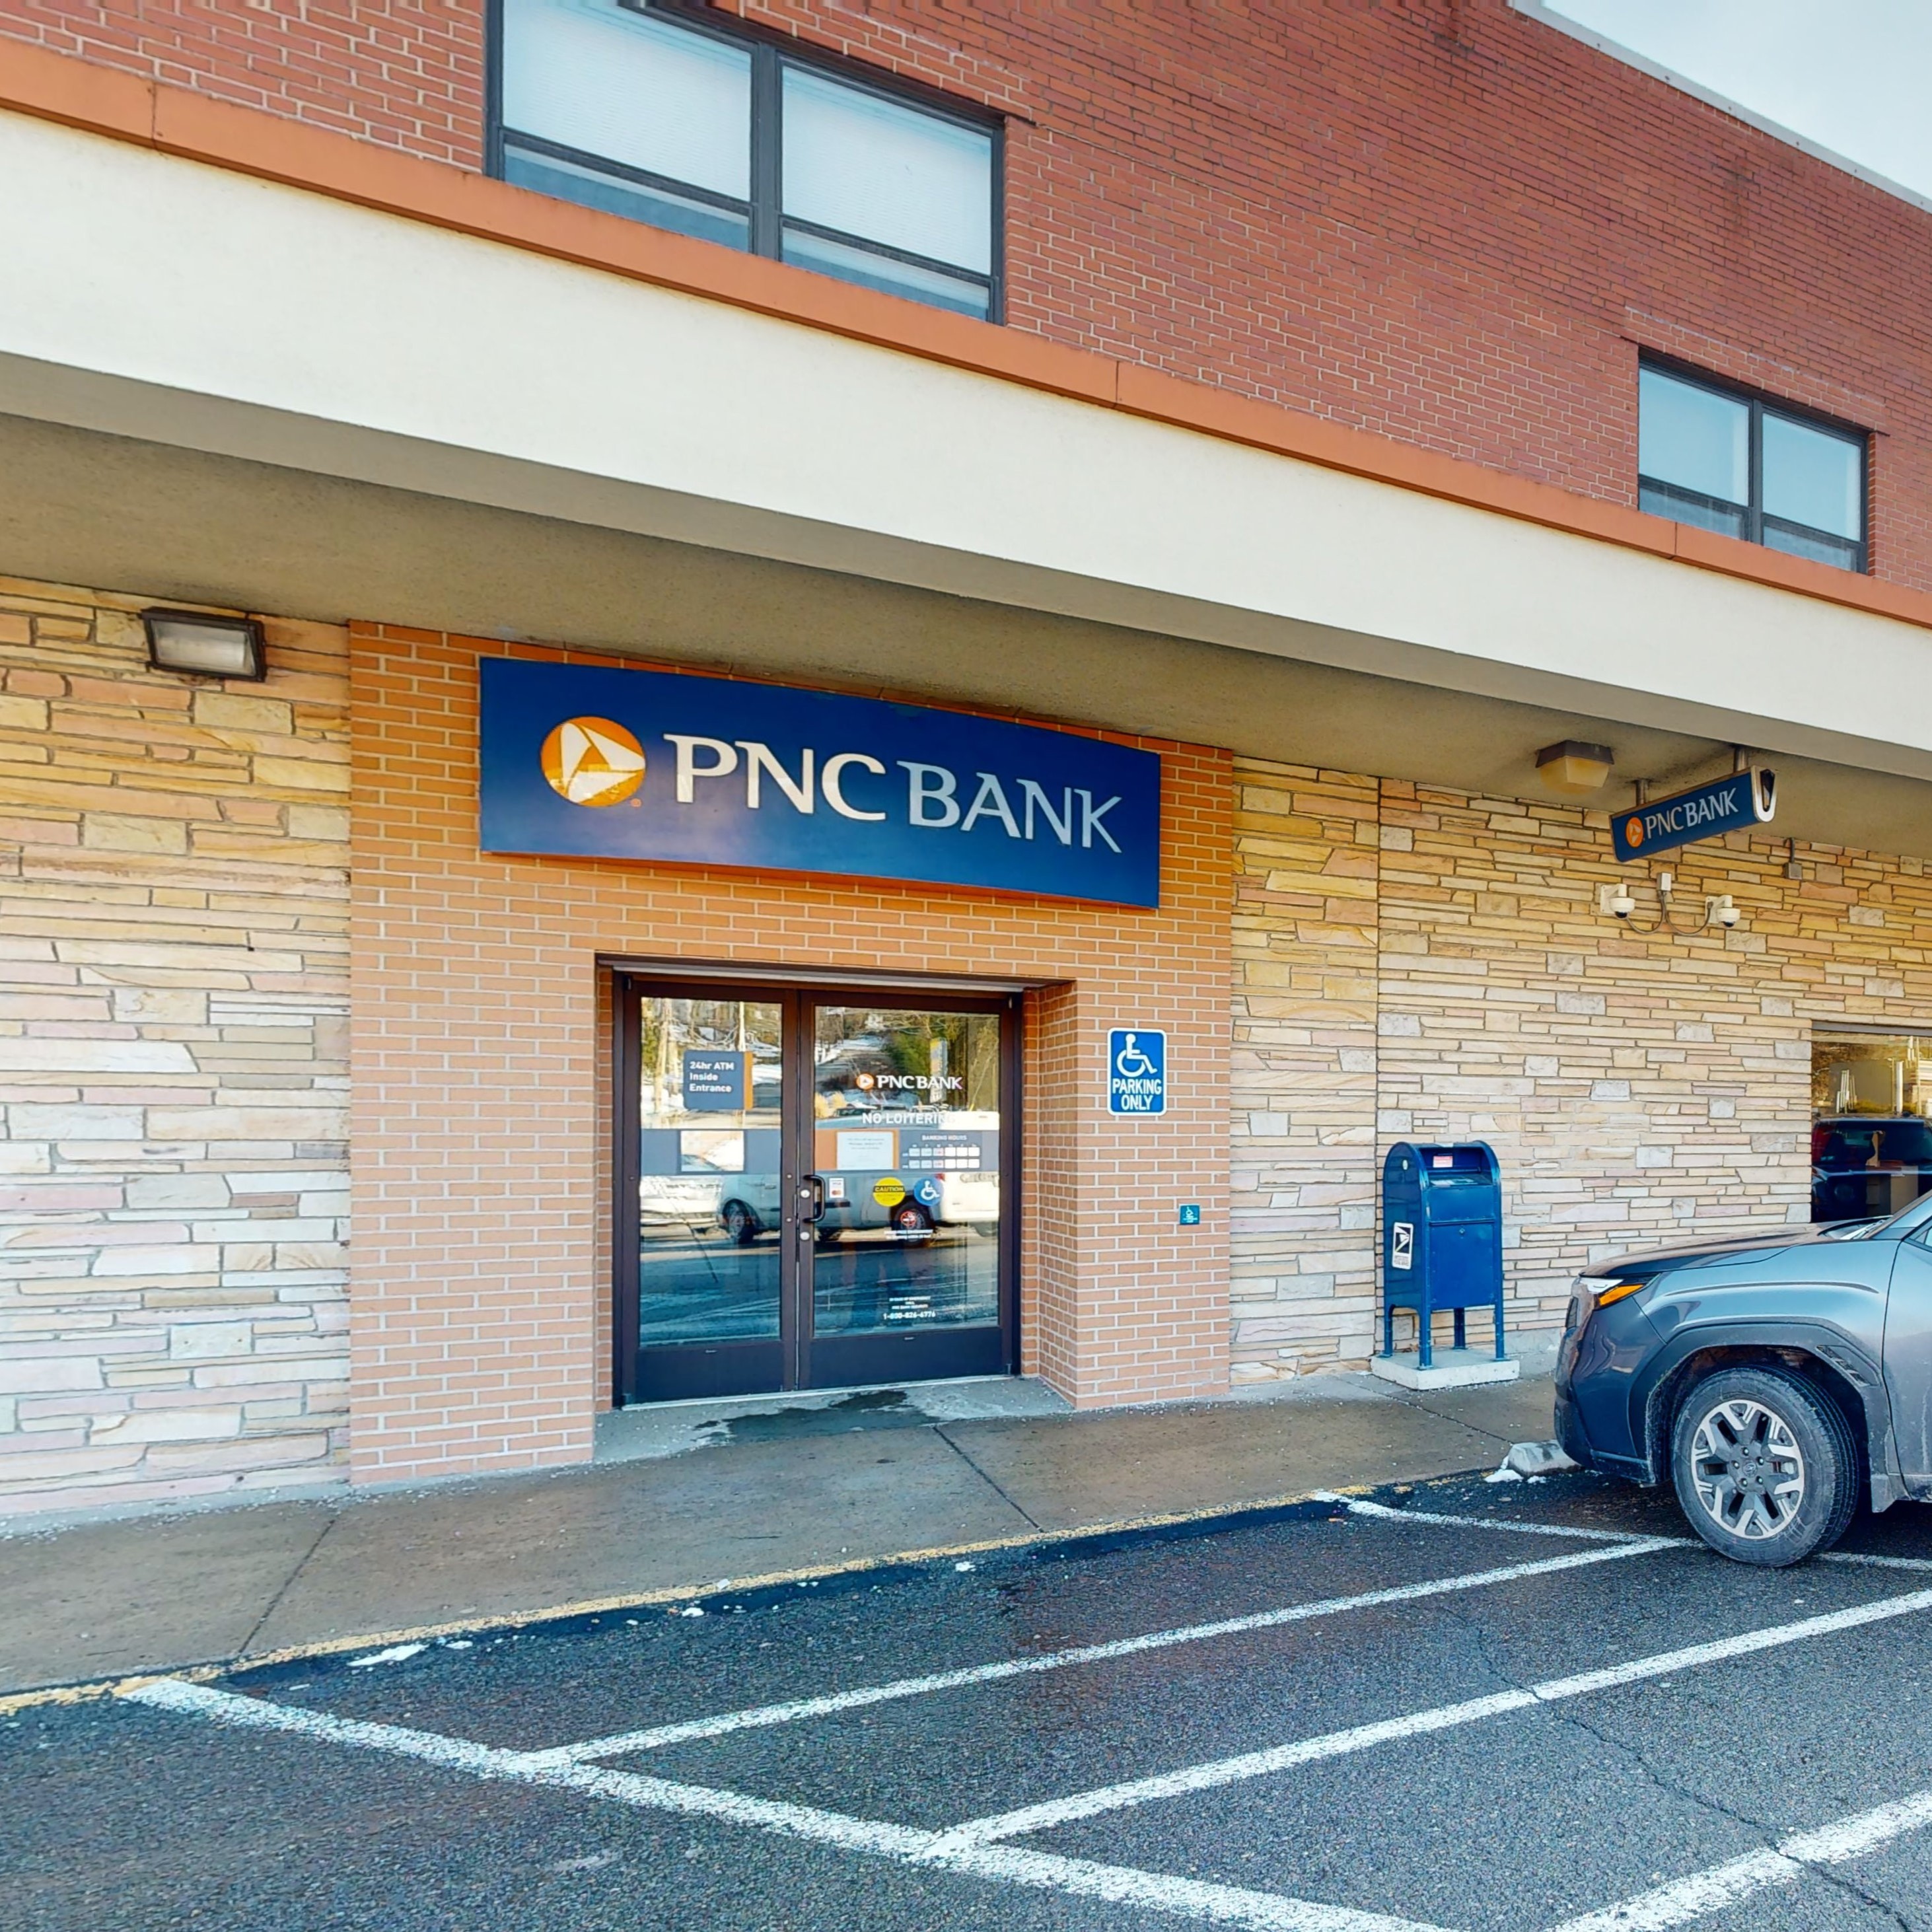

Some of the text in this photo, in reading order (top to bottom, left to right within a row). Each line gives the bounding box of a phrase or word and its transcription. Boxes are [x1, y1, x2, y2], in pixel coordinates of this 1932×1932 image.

[664, 733, 1122, 853] PNC BANK
[1644, 787, 1738, 840] PNC BANK
[689, 1061, 734, 1070] 24hr ATM
[690, 1072, 718, 1081] Inside
[876, 1075, 962, 1090] PNC BANK
[689, 1083, 732, 1092] Entrance
[1112, 1078, 1162, 1094] PARKING
[1121, 1094, 1153, 1110] ONLY
[862, 1113, 882, 1124] NO
